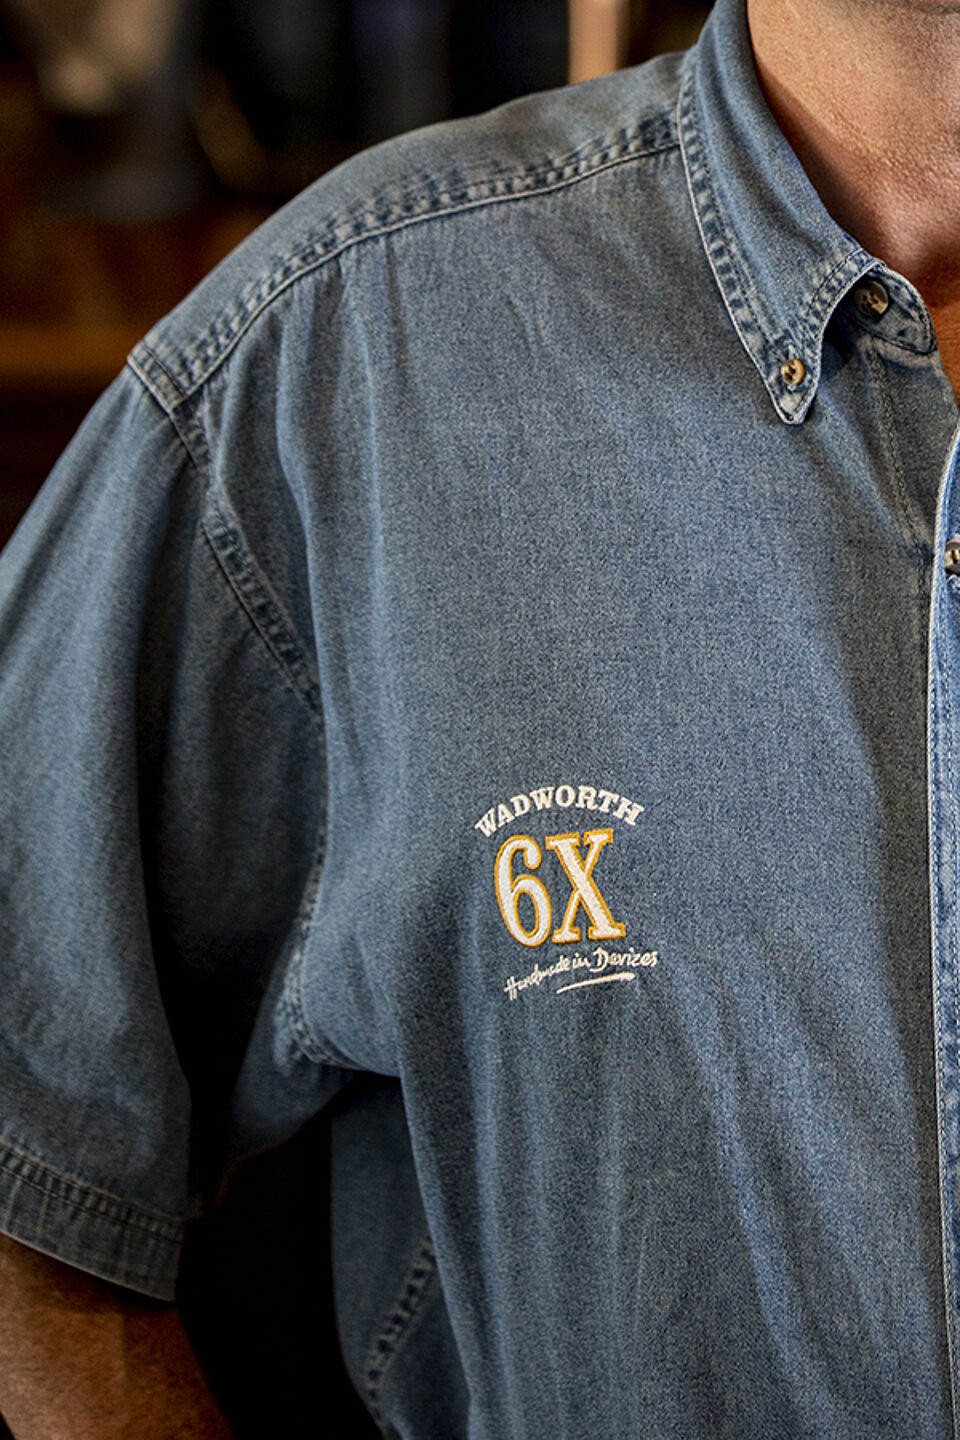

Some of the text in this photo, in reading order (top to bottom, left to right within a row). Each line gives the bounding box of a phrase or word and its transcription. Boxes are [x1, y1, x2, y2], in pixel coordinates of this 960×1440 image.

[474, 785, 645, 837] WADWORTH
[494, 828, 626, 948] 6X
[572, 952, 591, 969] in
[589, 947, 659, 973] Devizes
